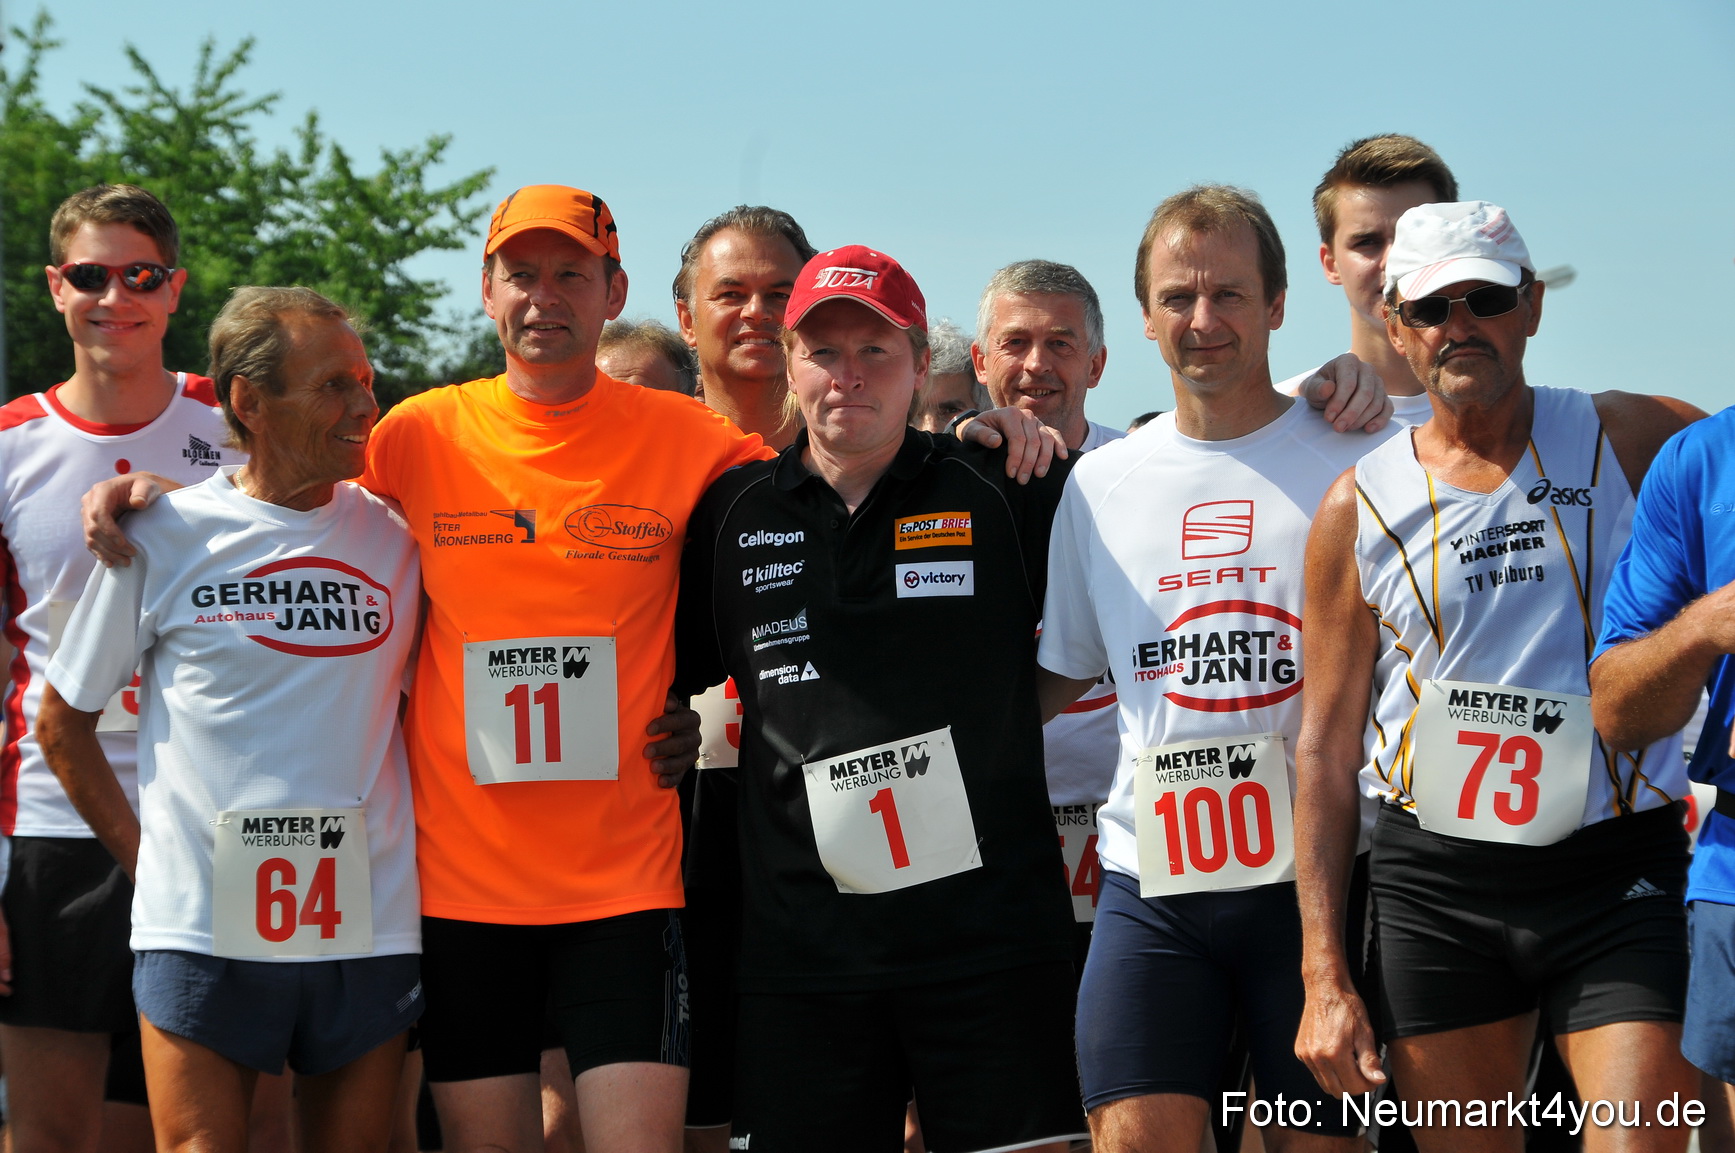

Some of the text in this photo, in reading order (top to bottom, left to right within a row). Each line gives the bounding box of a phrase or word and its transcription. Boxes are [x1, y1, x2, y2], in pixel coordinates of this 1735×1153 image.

[182, 449, 221, 460] BLOEMEN
[1550, 487, 1593, 507] asics
[433, 521, 460, 533] PETER
[612, 521, 667, 539] Stoffels
[941, 518, 970, 529] BRIEF
[1465, 519, 1546, 546] INTERSPORT
[434, 533, 513, 547] KRONENBERG
[738, 530, 805, 548] Cellagon
[932, 530, 955, 538] Deutschen
[565, 550, 605, 560] Florale
[1460, 536, 1546, 565] HACKNER
[755, 579, 795, 593] sportswear
[921, 571, 966, 586] victory
[1158, 567, 1277, 592] SEAT
[1465, 564, 1545, 594] TV Velburg
[191, 580, 379, 608] GERHART &
[194, 611, 276, 624] Autohaus
[275, 607, 381, 635] JÄNIG
[751, 616, 808, 641] AMADEUS
[1132, 630, 1276, 669] ERHART
[1277, 634, 1294, 651] &
[488, 647, 558, 667] MEYER
[488, 664, 559, 679] WERBUNG
[758, 664, 799, 681] dimension
[778, 674, 800, 685] data
[1181, 656, 1297, 686] JÄNIG
[1448, 689, 1529, 714] MEYER
[505, 682, 562, 765] 11
[1448, 707, 1528, 727] WERBUNG
[829, 750, 899, 782] MEYER
[1155, 747, 1222, 772] MEYER
[831, 766, 902, 793] WERBUNG
[1155, 765, 1225, 785] WERBUNG
[1457, 730, 1543, 826] 73
[241, 816, 316, 835] MEYER
[868, 787, 911, 870] 1
[1154, 781, 1276, 876] 100
[241, 834, 316, 848] WERBUNG
[255, 857, 342, 943] 64
[678, 972, 690, 1024] TAO
